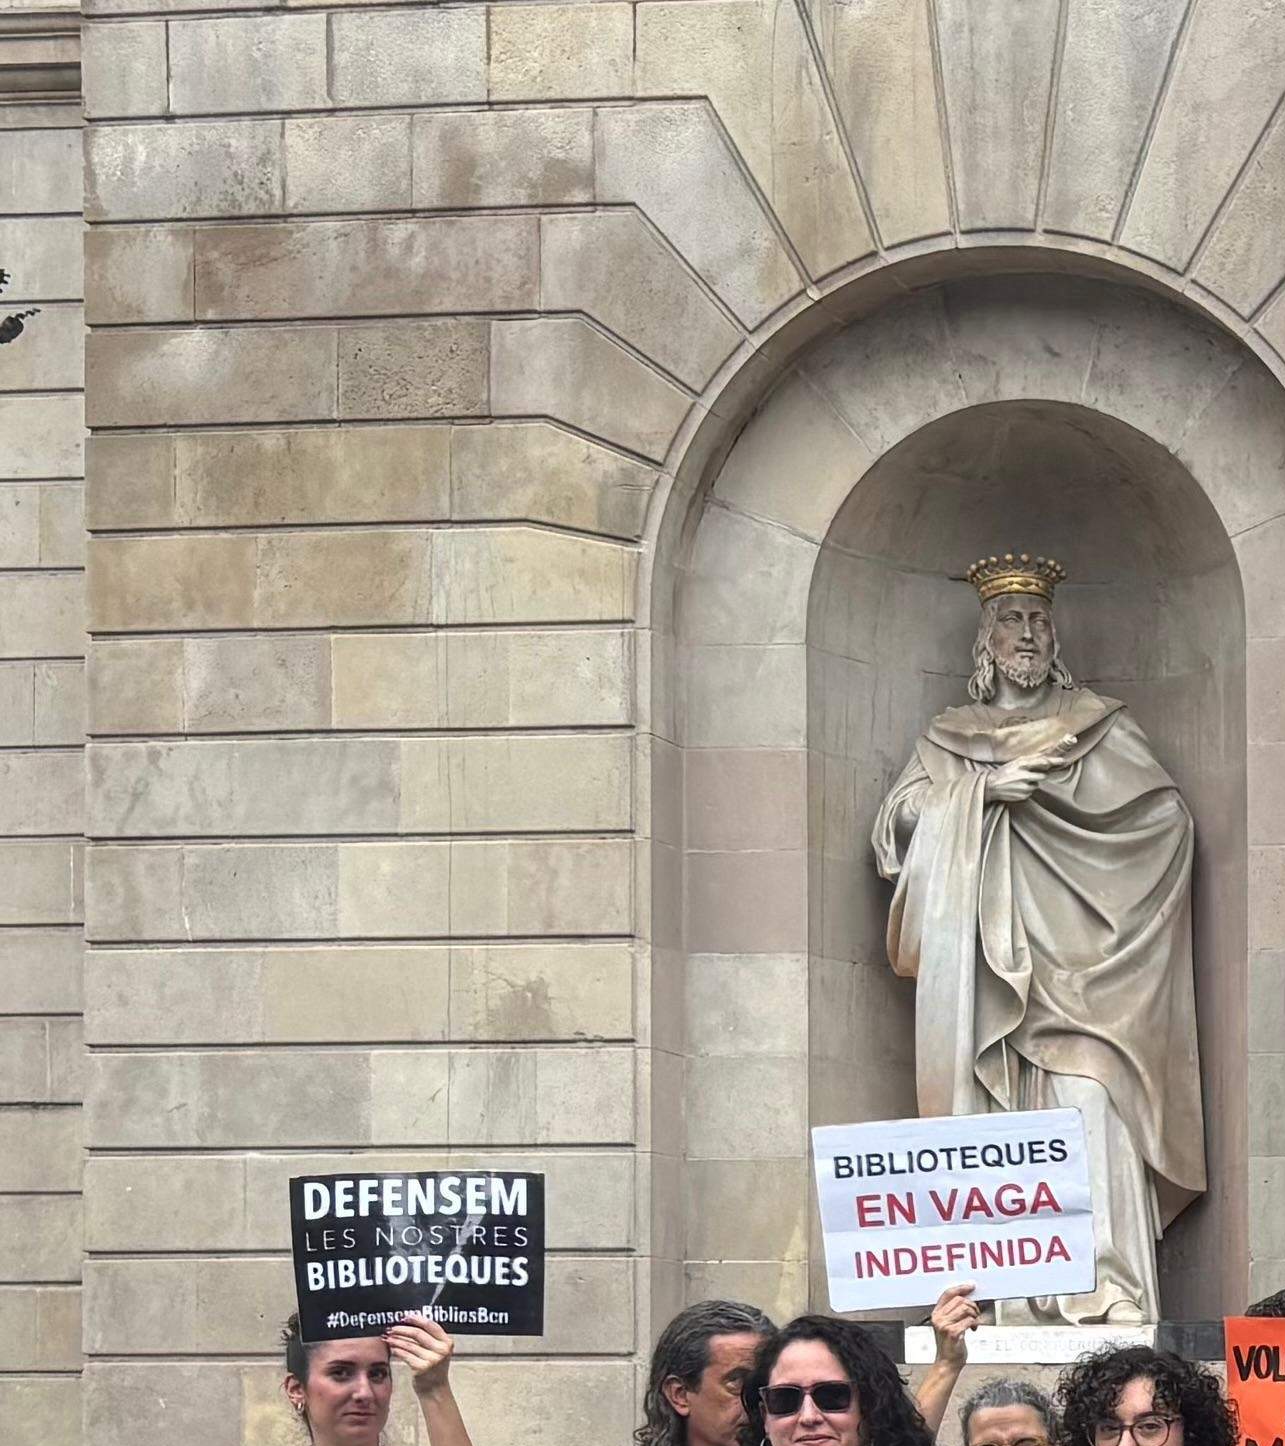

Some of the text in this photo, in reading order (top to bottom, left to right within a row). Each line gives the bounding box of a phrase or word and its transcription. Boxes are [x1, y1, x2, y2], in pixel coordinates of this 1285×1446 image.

[833, 1139, 1068, 1179] BIBLIOTEQUES
[303, 1177, 527, 1220] DEFENSEM
[856, 1182, 1062, 1227] EN VAGA
[306, 1226, 528, 1252] LES NOSTRES
[854, 1235, 1071, 1279] INDEFINIDA
[307, 1254, 529, 1291] BIBLIOTEQUES
